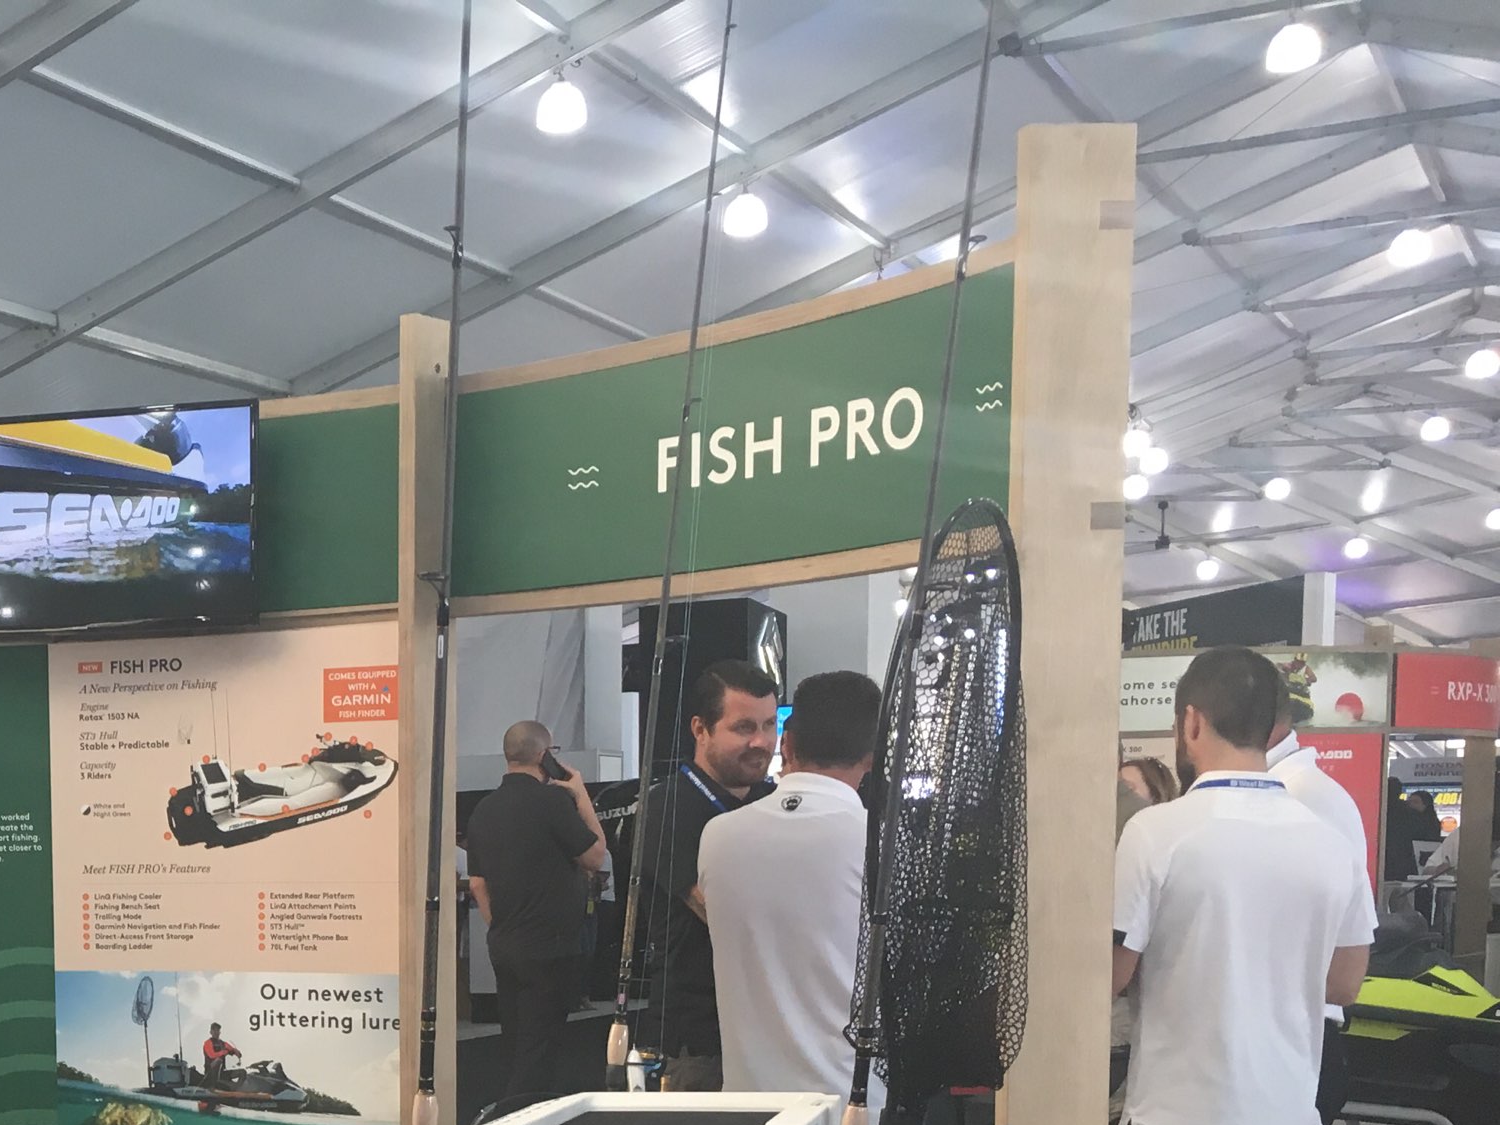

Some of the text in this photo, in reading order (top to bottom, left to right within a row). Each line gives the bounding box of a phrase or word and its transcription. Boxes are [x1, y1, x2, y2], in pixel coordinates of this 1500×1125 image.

[657, 386, 925, 493] FISH PRO
[1163, 607, 1188, 637] THE
[110, 659, 144, 674] FISH
[149, 657, 183, 673] PRO
[328, 669, 397, 681] COMES EQUIPPED
[78, 678, 219, 695] A New Perspective on Fishing
[347, 682, 377, 691] WITH A
[1120, 680, 1155, 691] ome
[331, 693, 392, 707] GARMIN
[80, 702, 109, 713] Engine
[107, 712, 126, 720] 1503
[127, 712, 140, 720] NA
[338, 708, 386, 718] FISH FINDER
[98, 730, 119, 740] Hull
[79, 742, 109, 750] Stable
[118, 740, 170, 749] Predictable
[79, 761, 117, 771] Capacity
[1, 812, 30, 821] worked
[20, 823, 34, 831] the
[11, 833, 41, 843] fishing.
[8, 843, 32, 852] closer
[33, 844, 43, 852] to
[82, 864, 107, 875] Meet
[108, 864, 137, 874] FISH
[168, 863, 212, 874] Features
[112, 893, 138, 901] Fishing
[269, 892, 303, 900] Extended
[94, 903, 120, 911] Fishing
[143, 902, 161, 910] Seat
[287, 902, 332, 910] Attachment
[126, 923, 167, 931] Navigation
[165, 933, 194, 942] Storage
[95, 943, 127, 951] Boarding
[260, 983, 385, 1003] Our newest
[248, 1009, 353, 1034] glittering
